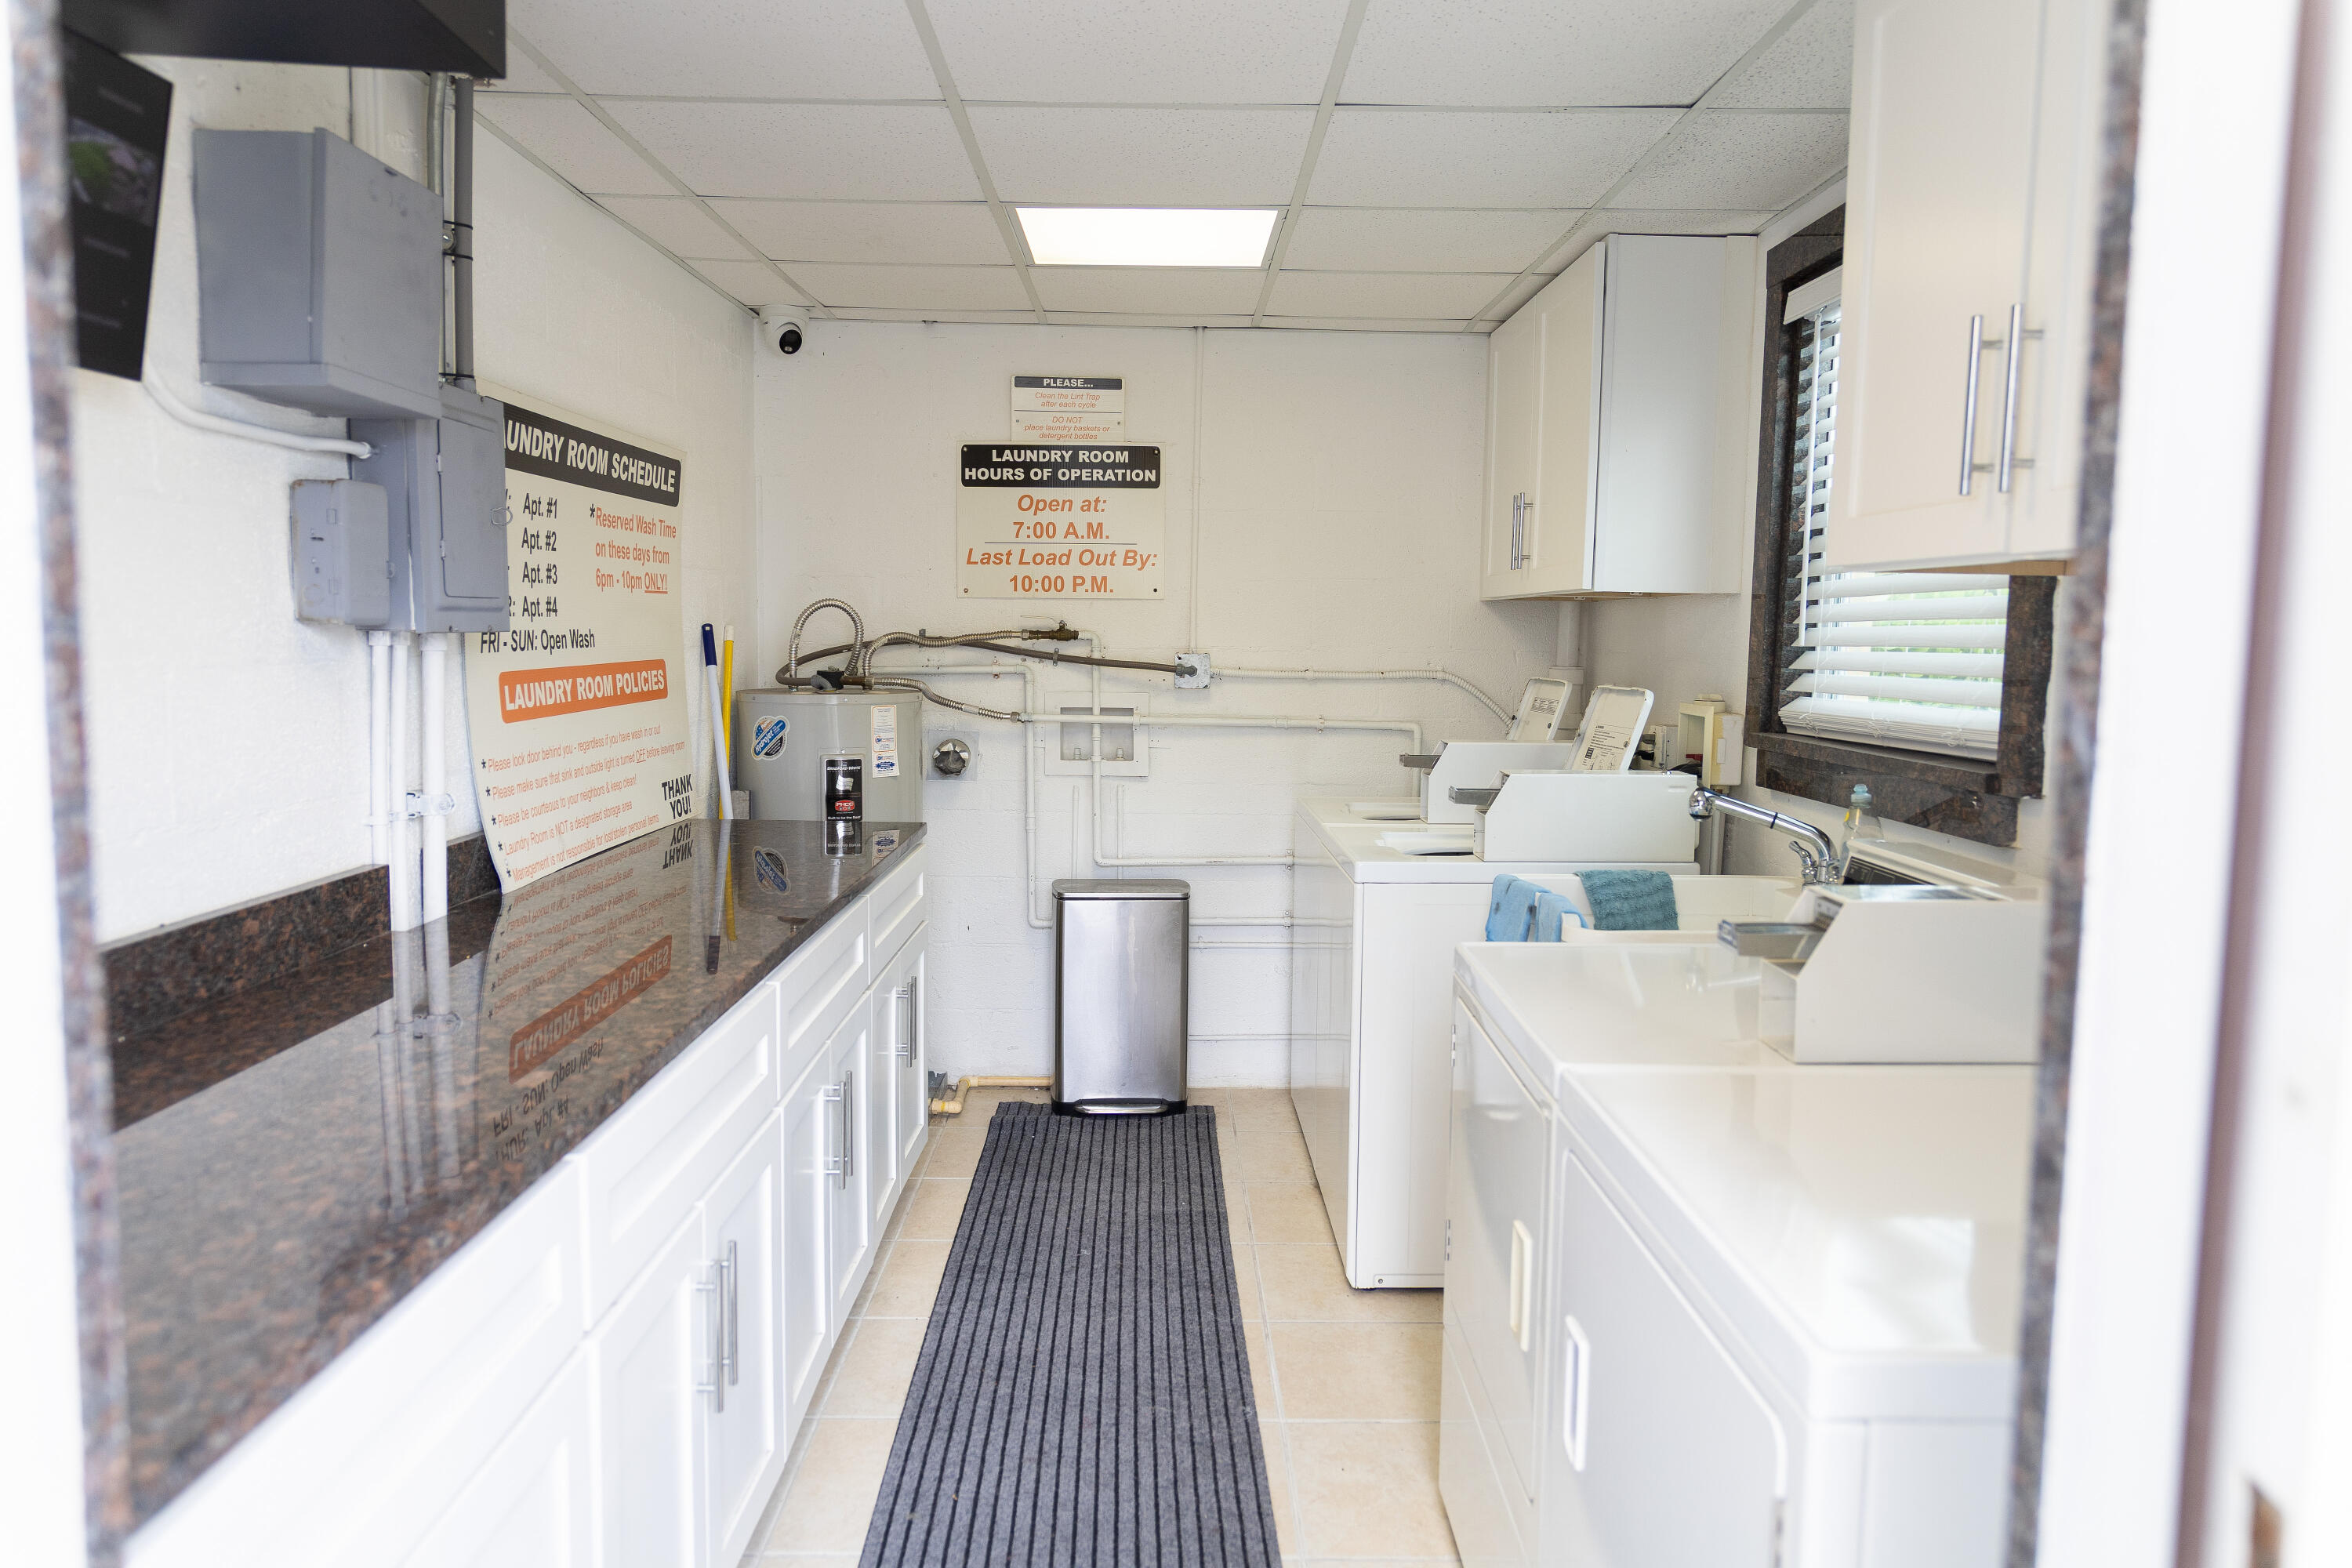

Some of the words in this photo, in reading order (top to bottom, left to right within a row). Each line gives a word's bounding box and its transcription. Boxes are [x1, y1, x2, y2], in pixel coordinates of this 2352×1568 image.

[1044, 379, 1094, 387] PLEASE...
[1086, 393, 1101, 401] Trap
[1045, 424, 1072, 433] laundry
[503, 418, 564, 463] UNDRY
[567, 439, 608, 476] ROOM
[612, 453, 676, 493] SCHEDULE
[992, 449, 1073, 463] LAUNDRY
[1078, 451, 1129, 463] ROOM
[964, 467, 1025, 481] HOURS
[1029, 468, 1052, 481] OF
[1058, 468, 1156, 481] OPERATION
[523, 493, 543, 521] Apt.
[546, 497, 557, 519] #1
[1018, 494, 1073, 516] Open
[1080, 496, 1107, 513] at:
[636, 514, 656, 536] Wash
[659, 519, 677, 539] Time
[1013, 521, 1057, 539] 7:00
[1063, 522, 1110, 539] A.M.
[521, 527, 542, 554] Apt.
[545, 530, 557, 552] #2
[595, 542, 606, 557] on
[608, 541, 630, 561] these
[633, 543, 651, 564] days
[652, 546, 670, 564] from
[966, 548, 1012, 565] Last
[1018, 549, 1072, 566] Load
[1078, 549, 1116, 567] Out
[1123, 549, 1158, 572] By:
[522, 561, 543, 588] Apt.
[546, 564, 557, 585] #3
[596, 568, 614, 592] 6pm
[622, 570, 642, 590] 10pm
[644, 572, 668, 592] ONLY!
[1010, 575, 1065, 593] 10:00
[1073, 575, 1114, 593] P.M.
[521, 596, 543, 622] Apt.
[546, 597, 558, 618] #4
[481, 631, 500, 653] FRI
[510, 630, 538, 652] SUN:
[541, 630, 568, 655] Open
[569, 628, 595, 648] Wash
[504, 678, 573, 711] LAUNDRY
[576, 674, 613, 702] ROOM
[615, 669, 665, 695] POLICIES
[488, 757, 510, 772] Please
[513, 752, 525, 767] lock
[527, 749, 540, 764] door
[542, 744, 561, 760] behind
[563, 744, 573, 759] you
[577, 736, 604, 753] regardless
[604, 734, 609, 746] if
[609, 735, 619, 747] you
[619, 731, 630, 742] have
[631, 728, 642, 739] wash
[643, 727, 648, 737] in
[492, 785, 515, 800] Please
[516, 779, 534, 793] make
[535, 776, 548, 789] sure
[549, 771, 561, 785] that
[561, 768, 572, 782] sink
[574, 765, 584, 778] and
[585, 760, 604, 775] outside
[604, 757, 615, 772] light
[615, 757, 620, 768] is
[620, 750, 636, 766] turned
[636, 748, 646, 763] OFF
[646, 746, 660, 759] before
[660, 742, 675, 755] leaving
[675, 741, 685, 751] room
[662, 774, 693, 800] THANK
[498, 812, 520, 828] Please
[521, 808, 529, 820] be
[531, 800, 559, 817] courteous
[560, 796, 565, 808] to
[567, 793, 579, 809] your
[580, 784, 604, 802] neighbors
[611, 779, 622, 792] keep
[670, 795, 691, 819] YOU!
[504, 835, 529, 855] Laundry
[530, 829, 548, 845] Room
[550, 827, 555, 838] is
[555, 819, 568, 835] NOT
[570, 821, 574, 831] a
[575, 808, 603, 828] designated
[604, 804, 621, 818] storage
[621, 800, 633, 812] area
[513, 854, 550, 881] Management
[551, 855, 556, 866] is
[557, 849, 565, 862] not
[566, 836, 595, 859] responsible
[604, 826, 627, 844] lost/stolen
[628, 817, 647, 834] personal
[648, 814, 659, 826] items
